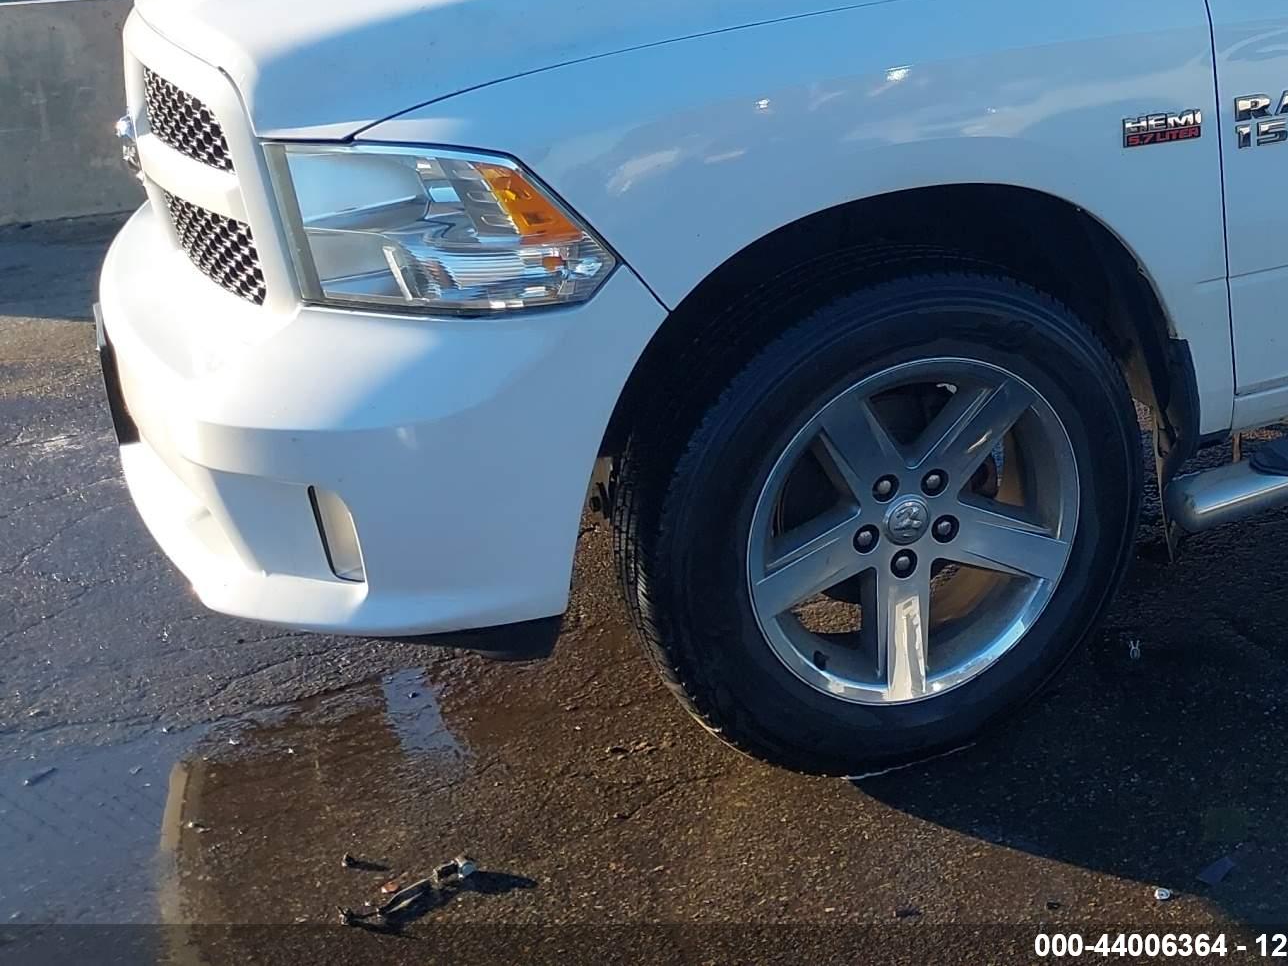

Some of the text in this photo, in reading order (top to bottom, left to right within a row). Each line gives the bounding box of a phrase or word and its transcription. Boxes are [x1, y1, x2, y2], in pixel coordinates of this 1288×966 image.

[1123, 109, 1202, 133] HEMI
[1127, 127, 1200, 146] 5.7 LITER
